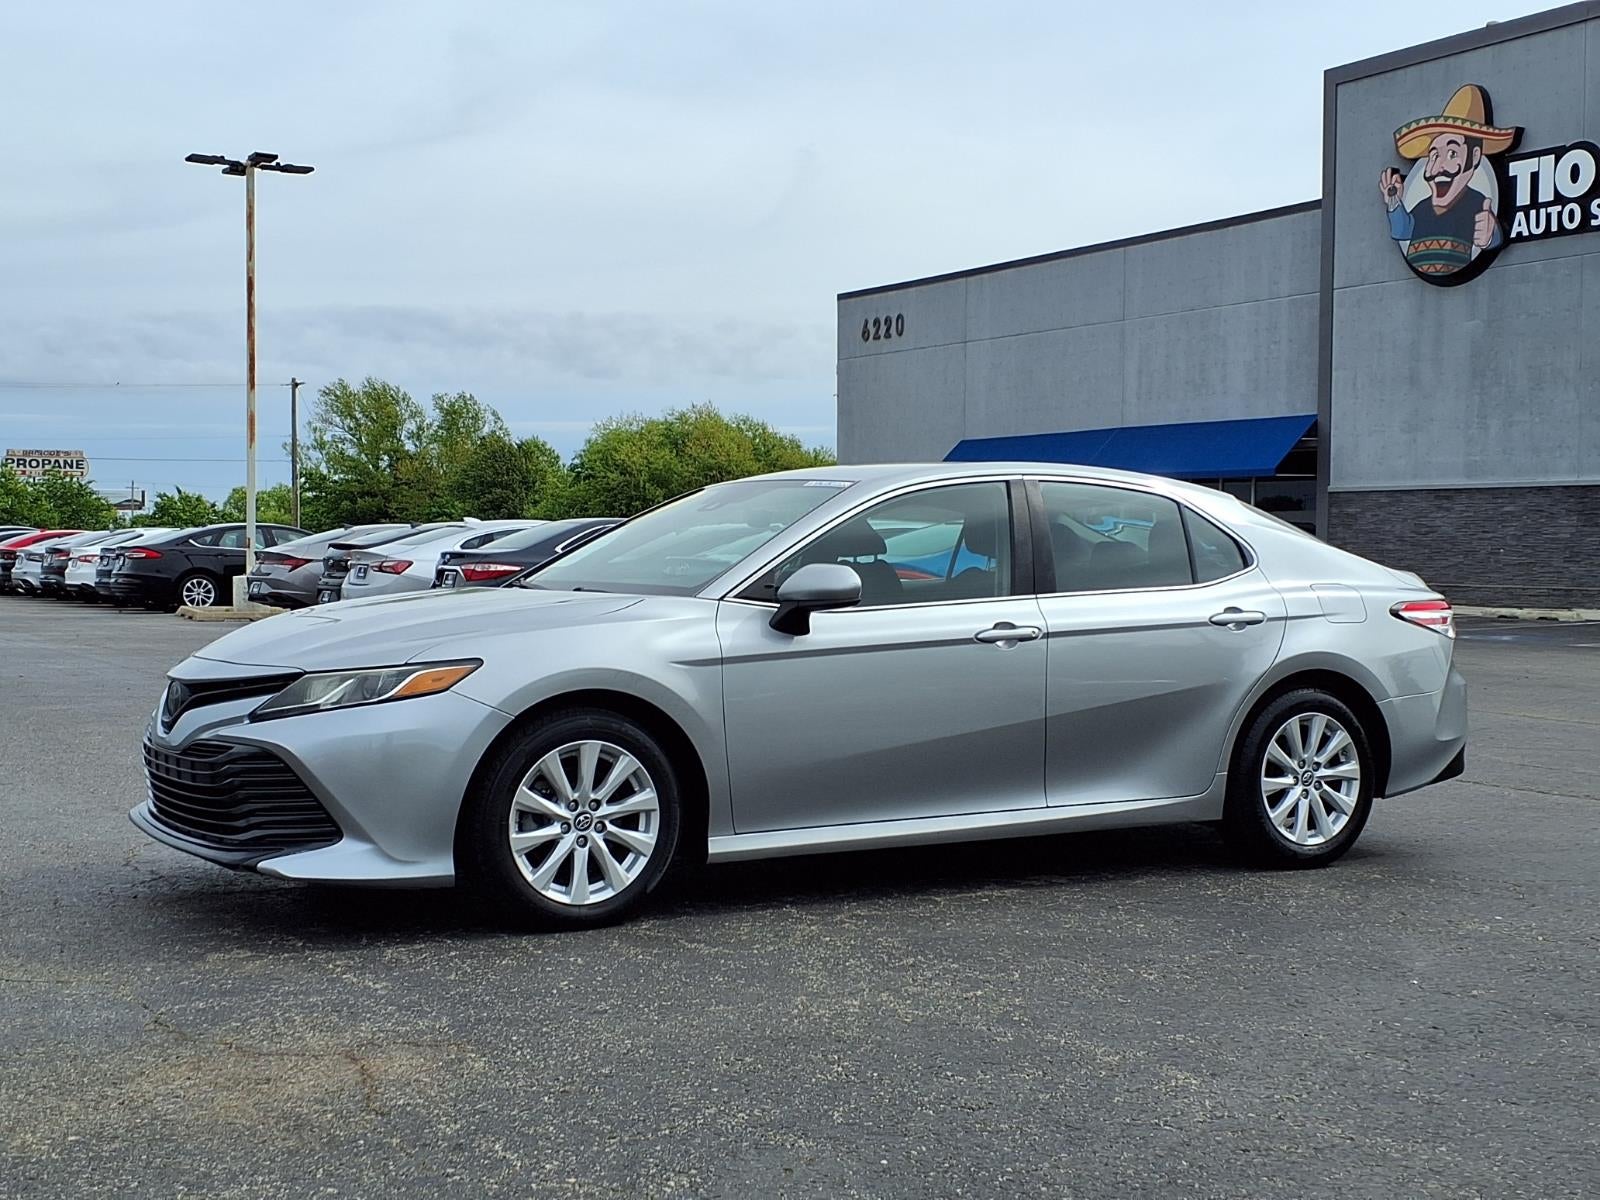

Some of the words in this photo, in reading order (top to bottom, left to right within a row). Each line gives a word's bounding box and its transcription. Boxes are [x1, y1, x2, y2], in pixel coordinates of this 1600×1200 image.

[1509, 149, 1596, 206] TIO
[1510, 203, 1582, 238] AUTO
[861, 313, 905, 342] 6220
[5, 458, 85, 470] PROPANE
